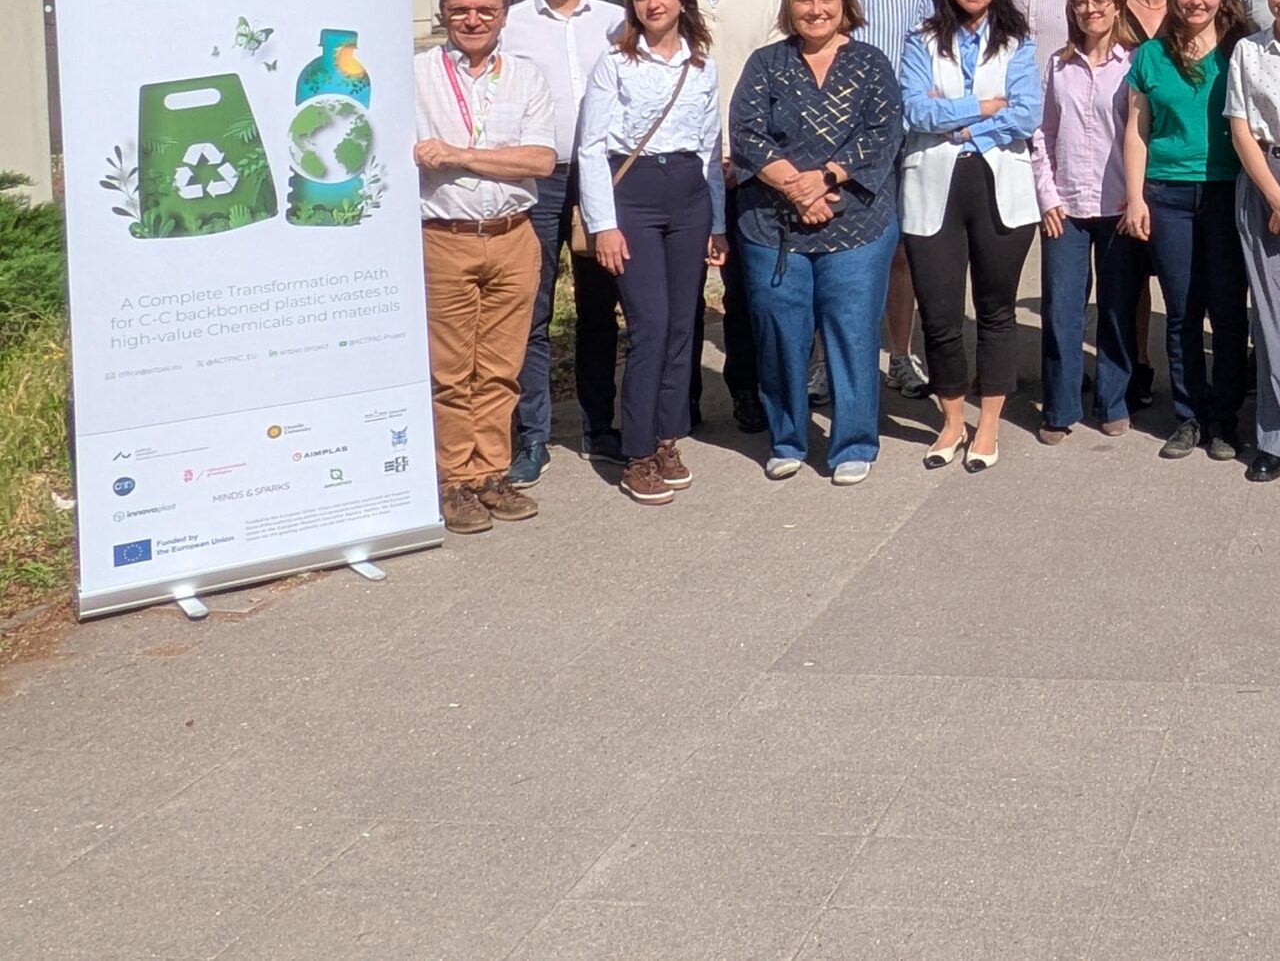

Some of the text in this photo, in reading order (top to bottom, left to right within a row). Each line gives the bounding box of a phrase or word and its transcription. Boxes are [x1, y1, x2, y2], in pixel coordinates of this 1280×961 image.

[120, 267, 389, 311] A Complete Transformation PAth
[110, 285, 399, 330] for C-C backboned plastic wastes to
[110, 300, 401, 350] high-value Chemicals and materials
[303, 446, 349, 459] AIMPLAS
[212, 481, 291, 503] MINDS & SPARKS
[126, 502, 177, 518] innovaplast
[156, 534, 198, 548] Funded by
[156, 534, 235, 556] the European Union
